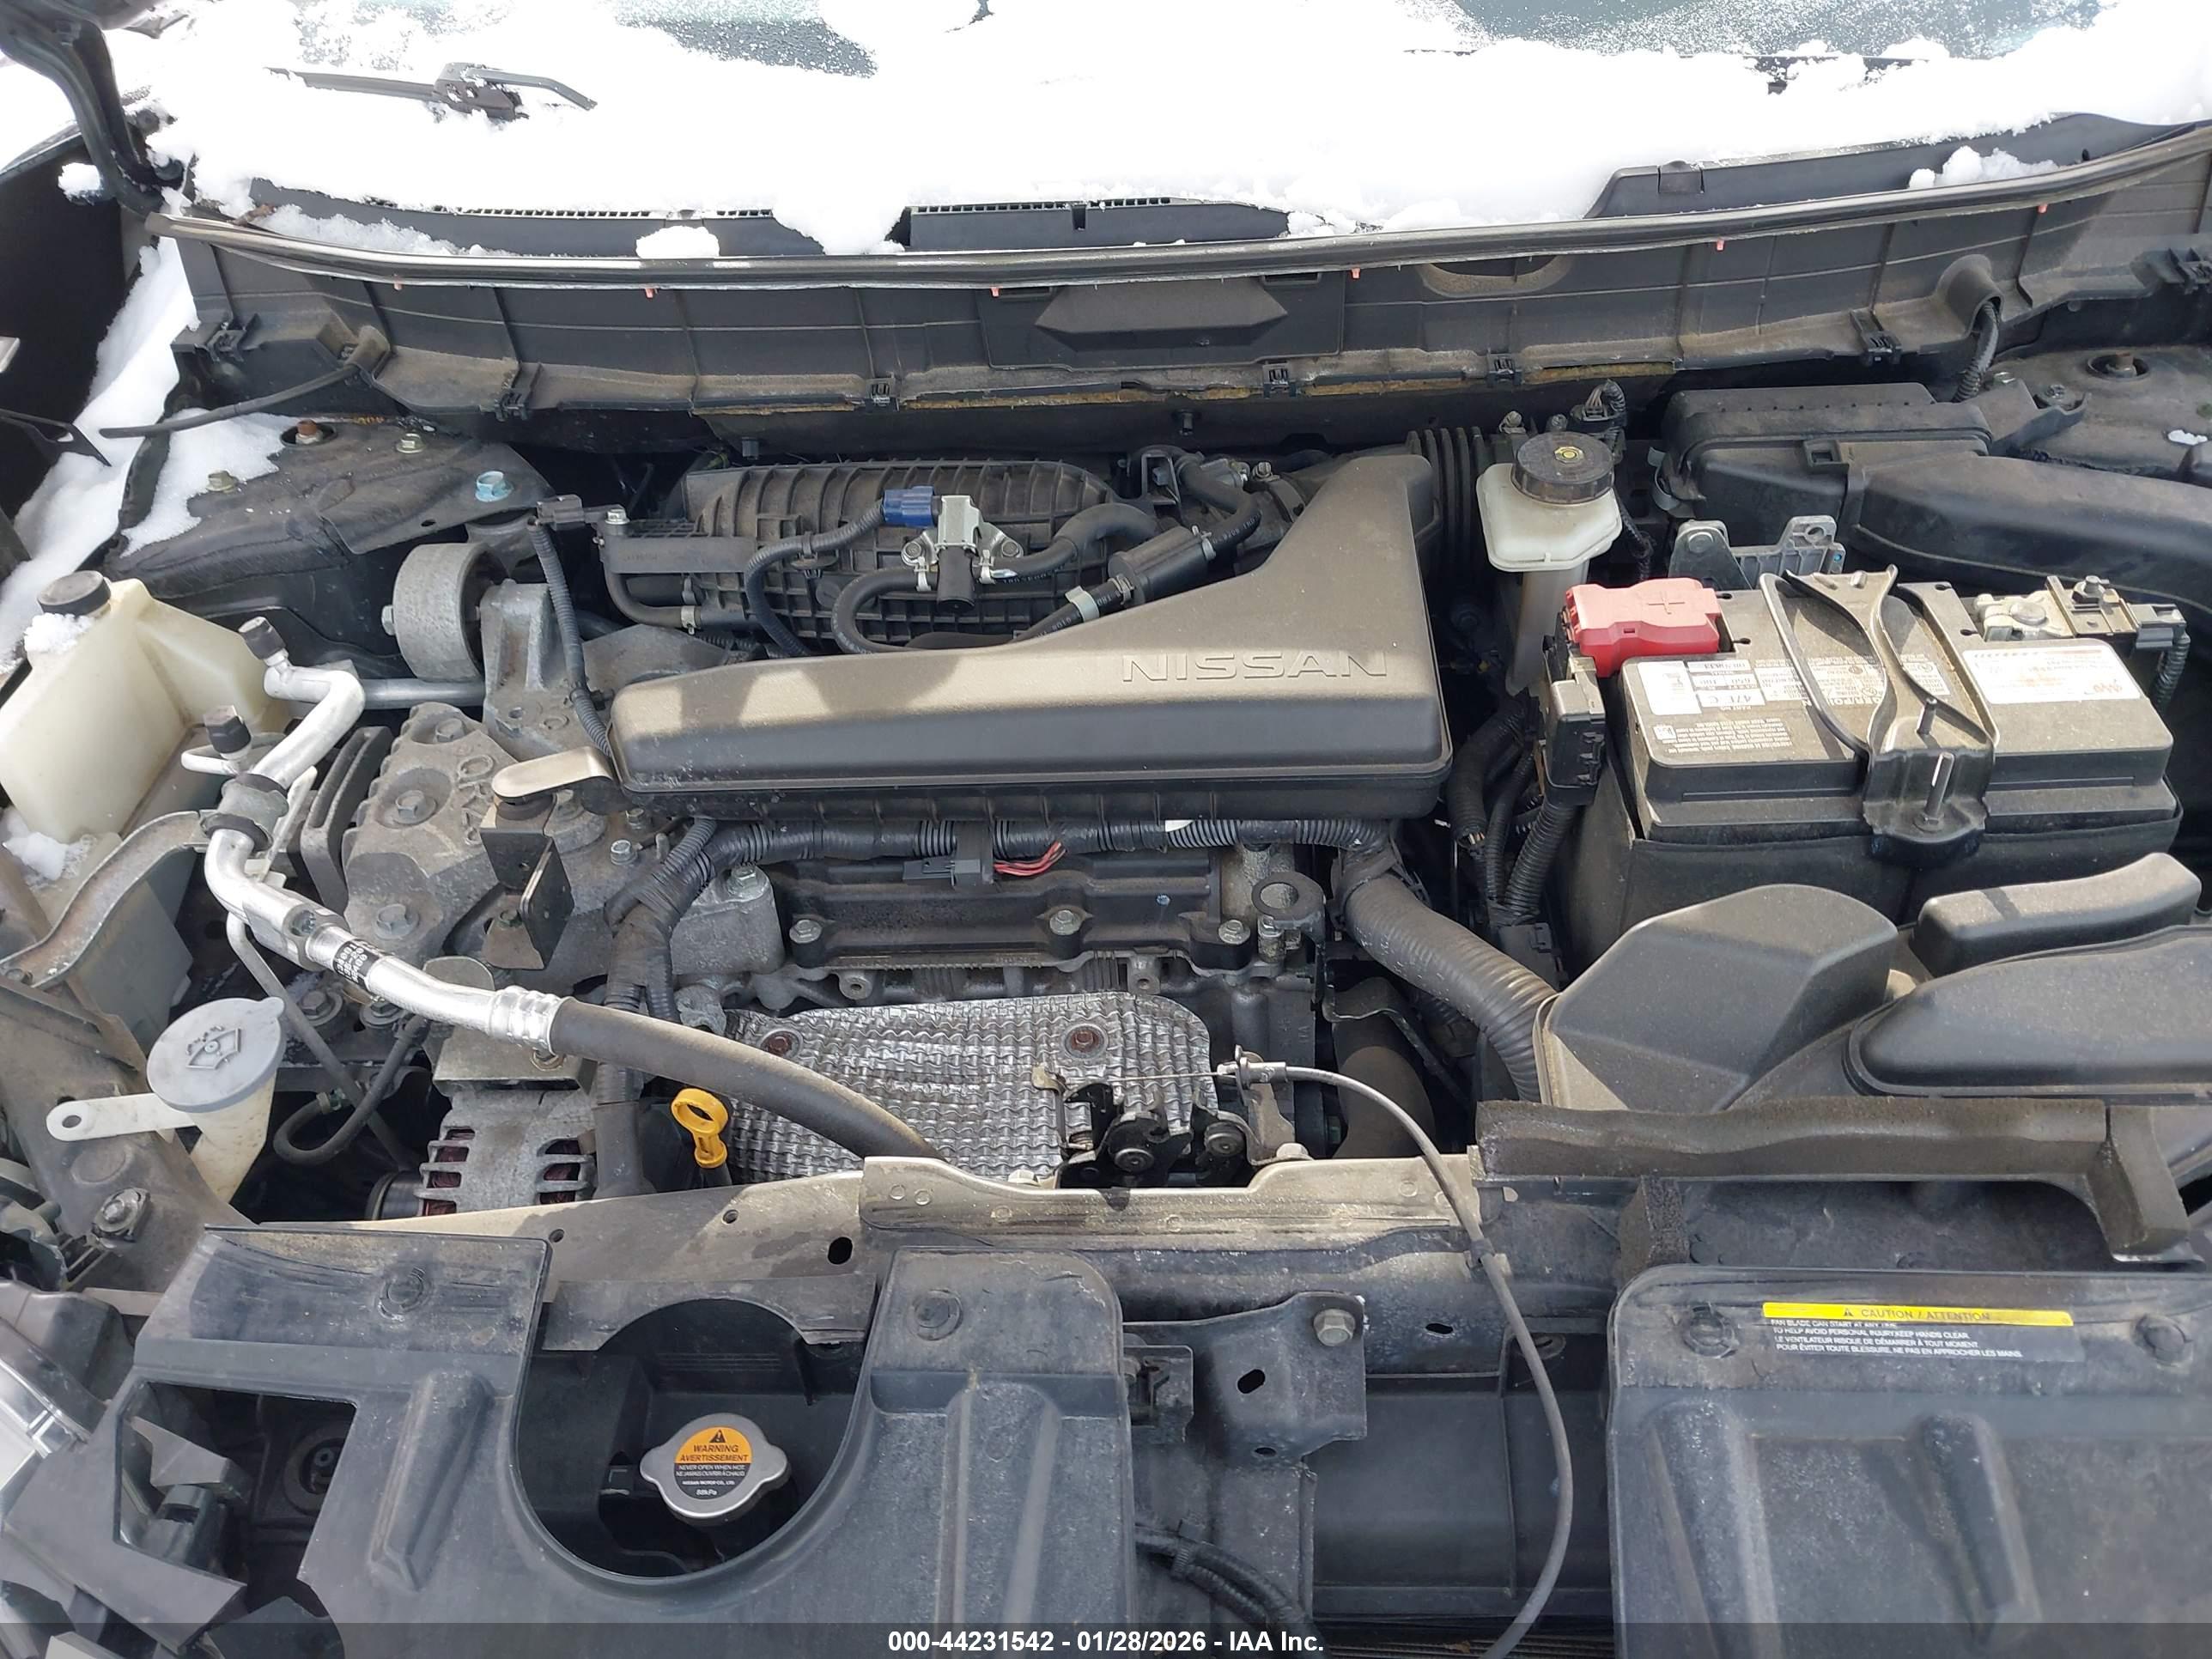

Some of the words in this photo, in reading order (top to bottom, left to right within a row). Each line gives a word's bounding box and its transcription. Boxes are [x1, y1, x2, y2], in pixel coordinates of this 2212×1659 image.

[1122, 650, 1388, 682] NISSAN
[1861, 1309, 1913, 1319] CAUTION
[1927, 1311, 1990, 1321] ATTENTION
[1785, 1336, 1832, 1345] VENTILATEUR
[1875, 1337, 1916, 1346] DÉMARRER
[1799, 1343, 1825, 1352] ÉVITER
[693, 1444, 739, 1453] WARNING
[680, 1454, 749, 1462] AVERTISSEMENT
